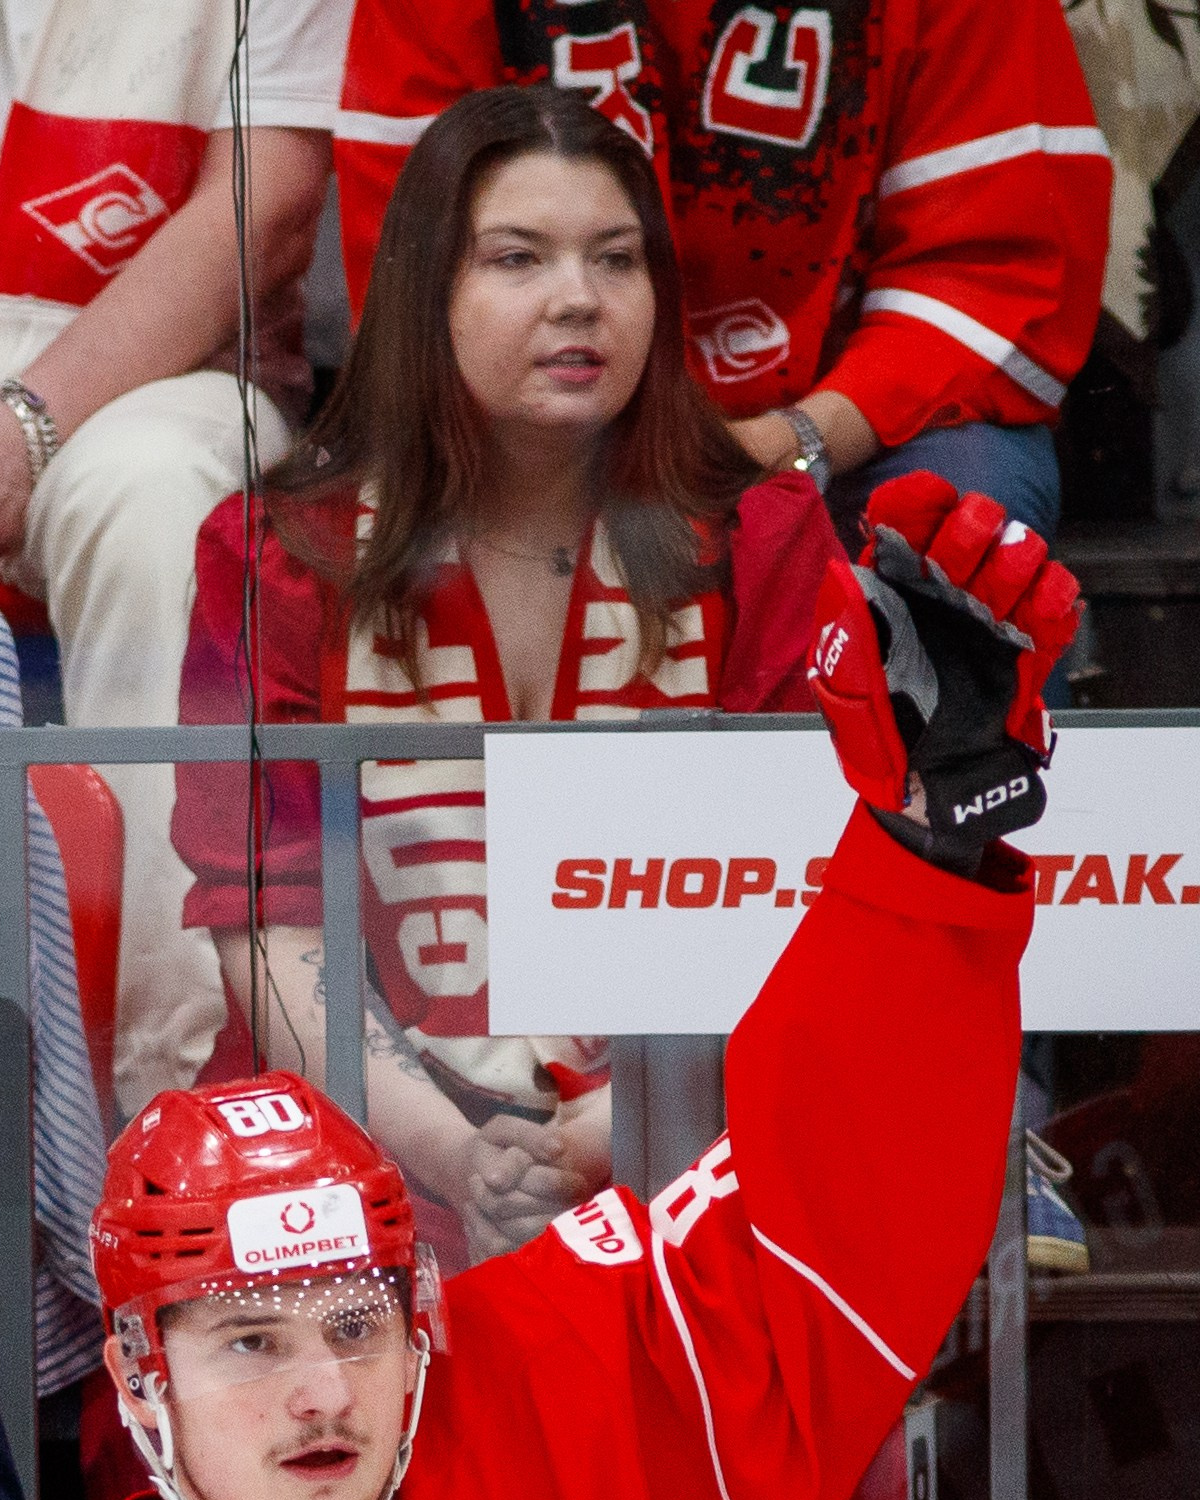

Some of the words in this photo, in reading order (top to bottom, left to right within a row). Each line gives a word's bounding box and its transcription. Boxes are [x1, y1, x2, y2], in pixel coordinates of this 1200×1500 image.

[823, 627, 850, 678] CCM
[953, 775, 1030, 825] CCM
[217, 1093, 306, 1138] 80
[244, 1234, 360, 1265] OLIMPBET
